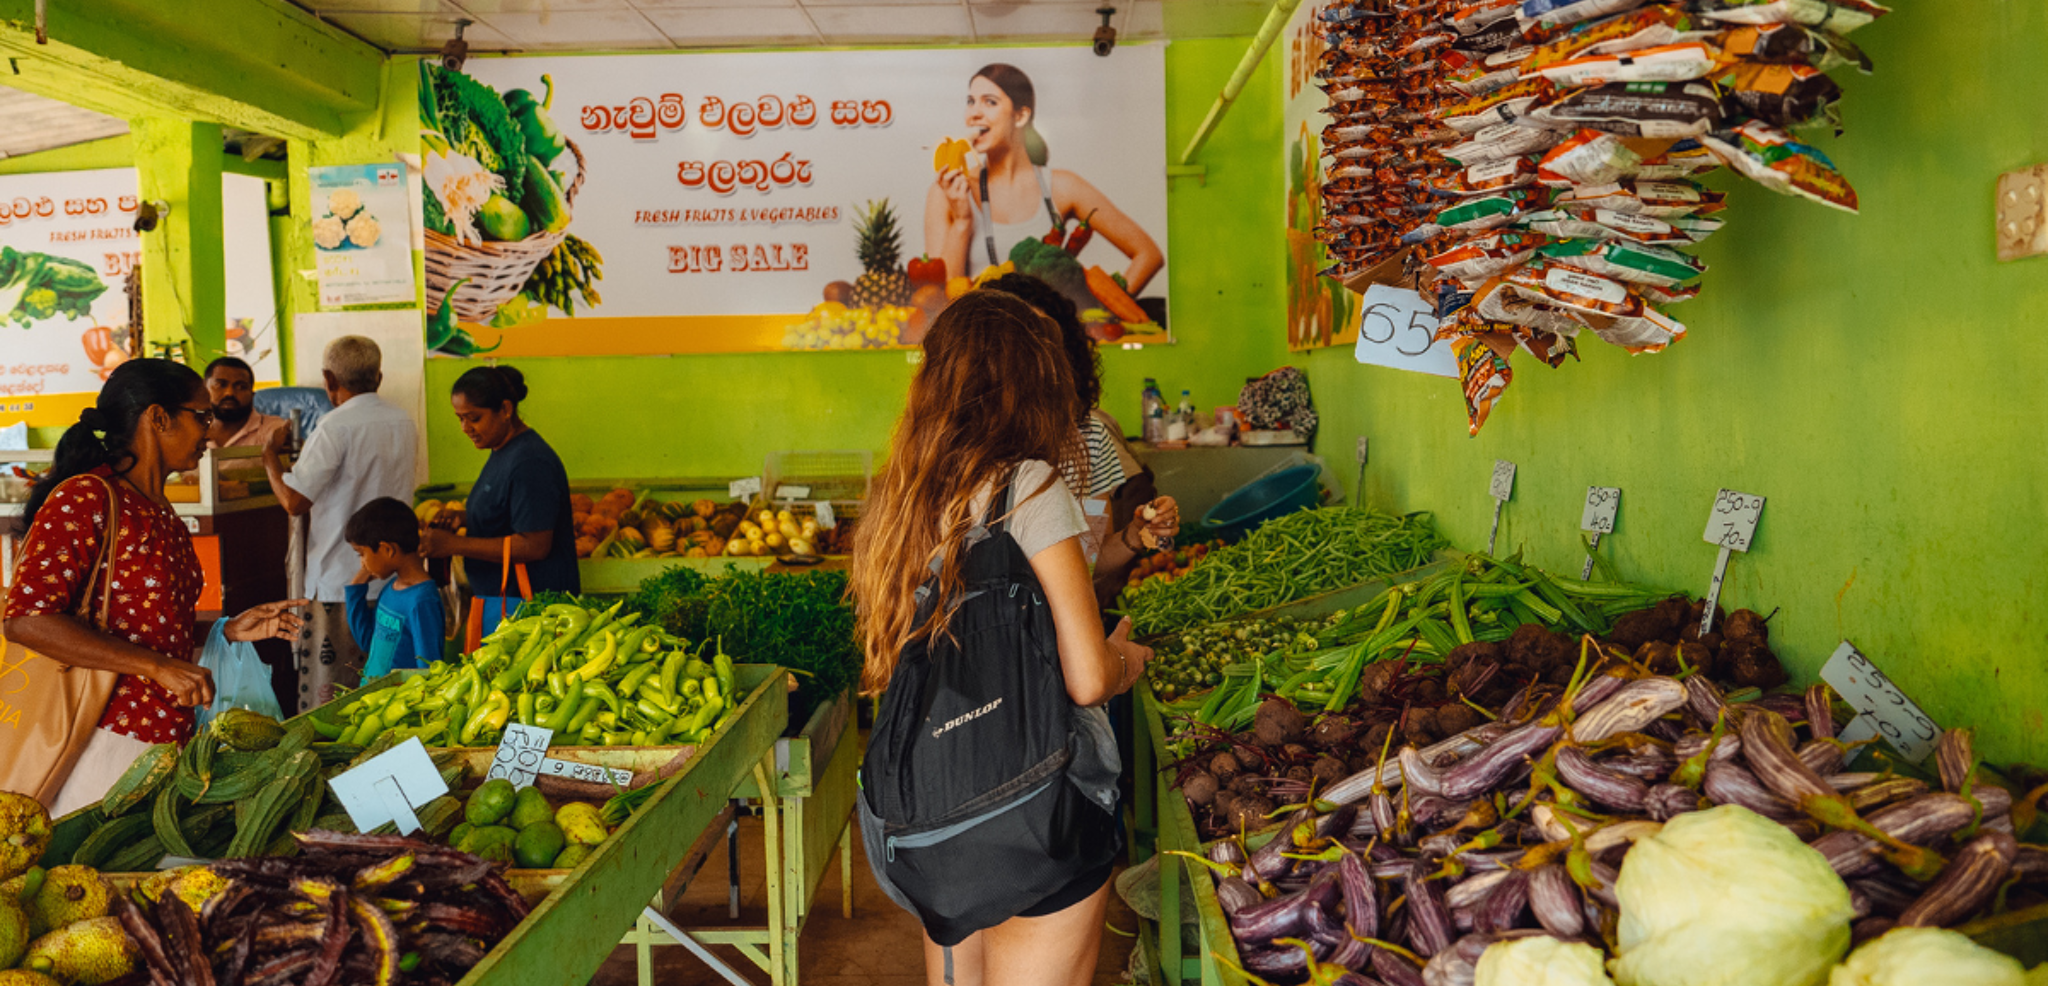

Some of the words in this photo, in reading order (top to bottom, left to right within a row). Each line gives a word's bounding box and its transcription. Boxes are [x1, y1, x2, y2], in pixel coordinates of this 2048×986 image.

[830, 99, 893, 126] සහ
[677, 152, 812, 194] පලතුරු
[634, 208, 681, 224] FRESH
[684, 208, 736, 224] FRUITS
[49, 231, 87, 243] FRESH
[90, 226, 132, 241] FRUITS
[667, 245, 724, 275] BIG
[729, 242, 809, 274] SALE
[1361, 302, 1437, 356] 65
[943, 698, 1003, 732] DUNLOP
